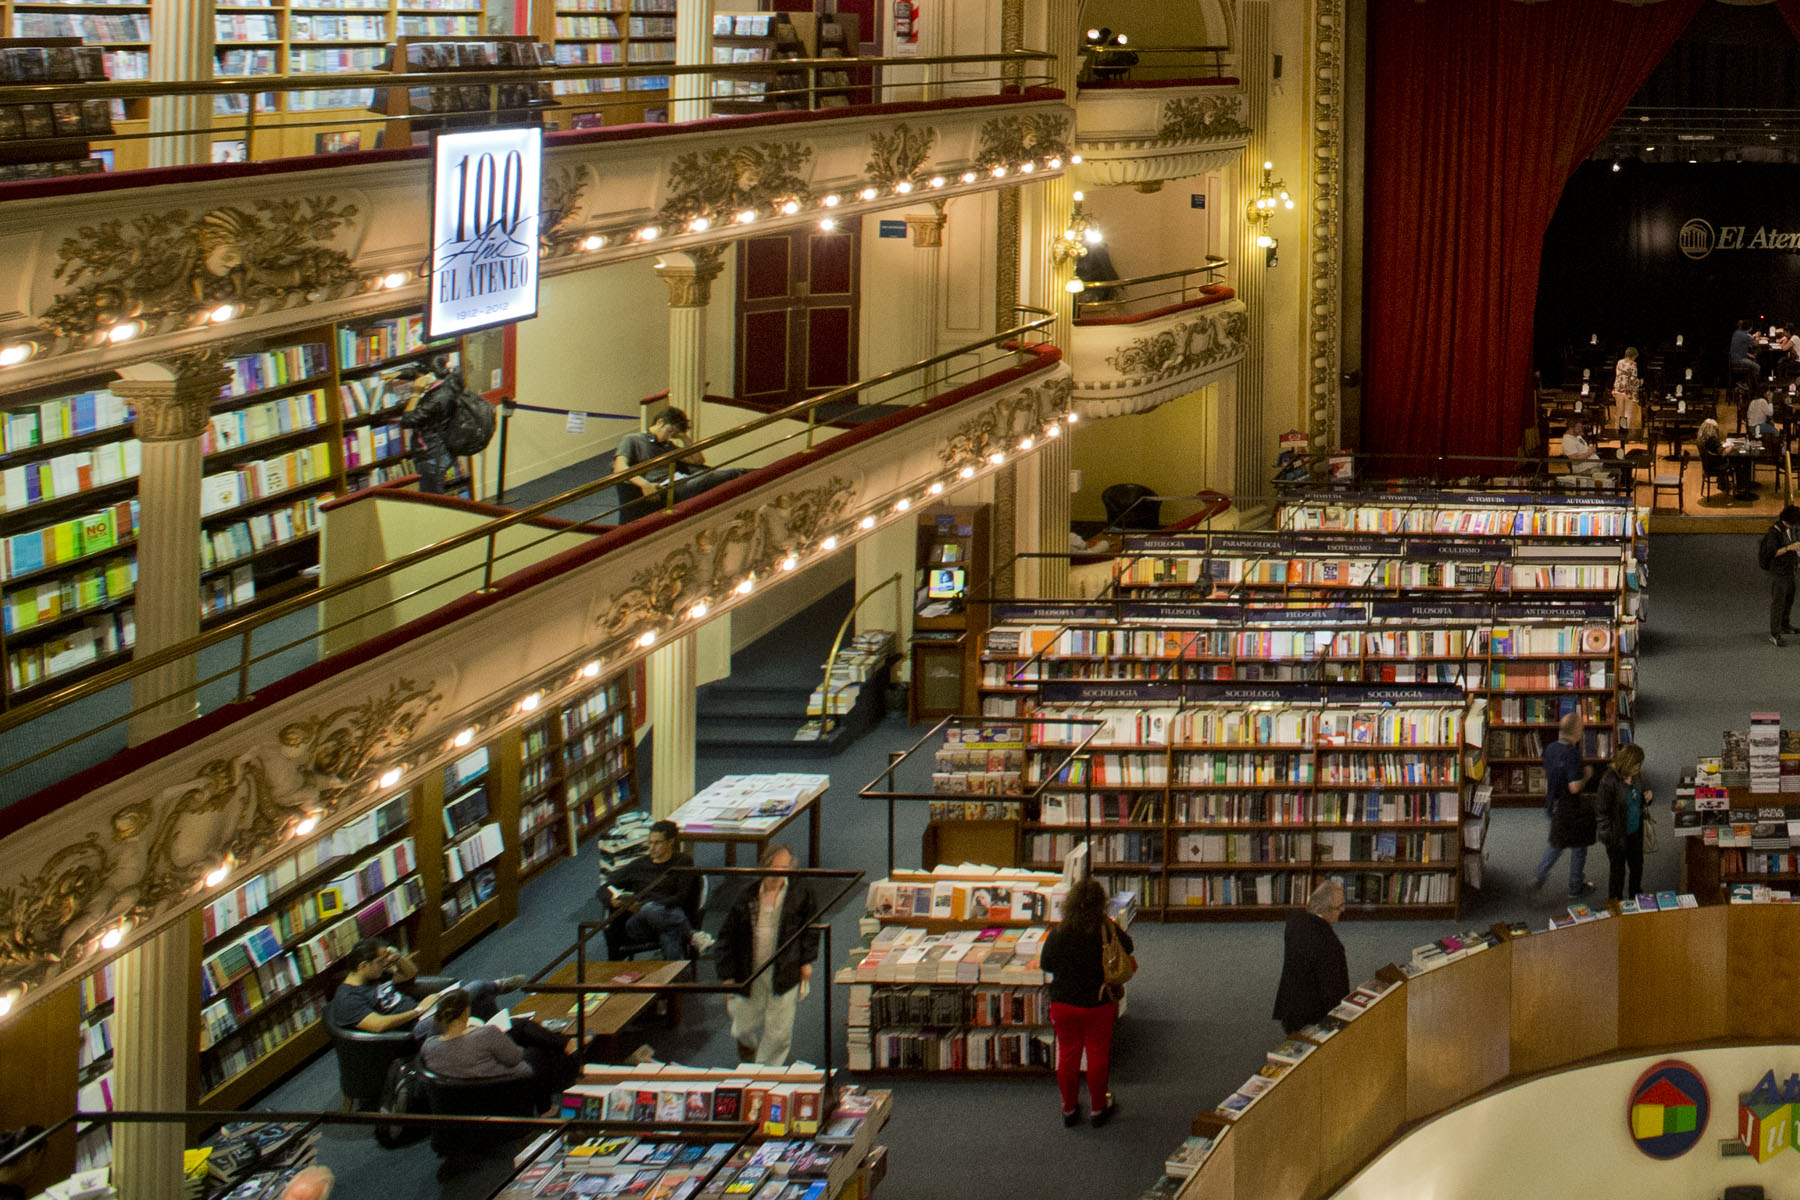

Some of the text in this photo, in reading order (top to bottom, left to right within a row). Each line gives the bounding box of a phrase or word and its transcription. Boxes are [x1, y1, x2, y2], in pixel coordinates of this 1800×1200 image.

[455, 150, 523, 243] 100
[1715, 226, 1746, 250] El
[440, 255, 529, 304] EL ATENEO
[1144, 540, 1185, 548] MITOLOGIA
[1222, 540, 1281, 549] PARAPSICOLOGIA
[1033, 608, 1075, 616] FILOSOFIA
[1160, 608, 1201, 616] FILOSOFIA
[1285, 610, 1327, 618] FILOSOFIA
[1411, 607, 1453, 615] FILOSOFIA
[1525, 608, 1586, 616] ANTROPOLOGIA
[1082, 688, 1138, 698] SOCIOLOGIA
[1225, 688, 1281, 698] SOCIOLOGIA
[1367, 689, 1423, 699] SOCIOLOGIA
